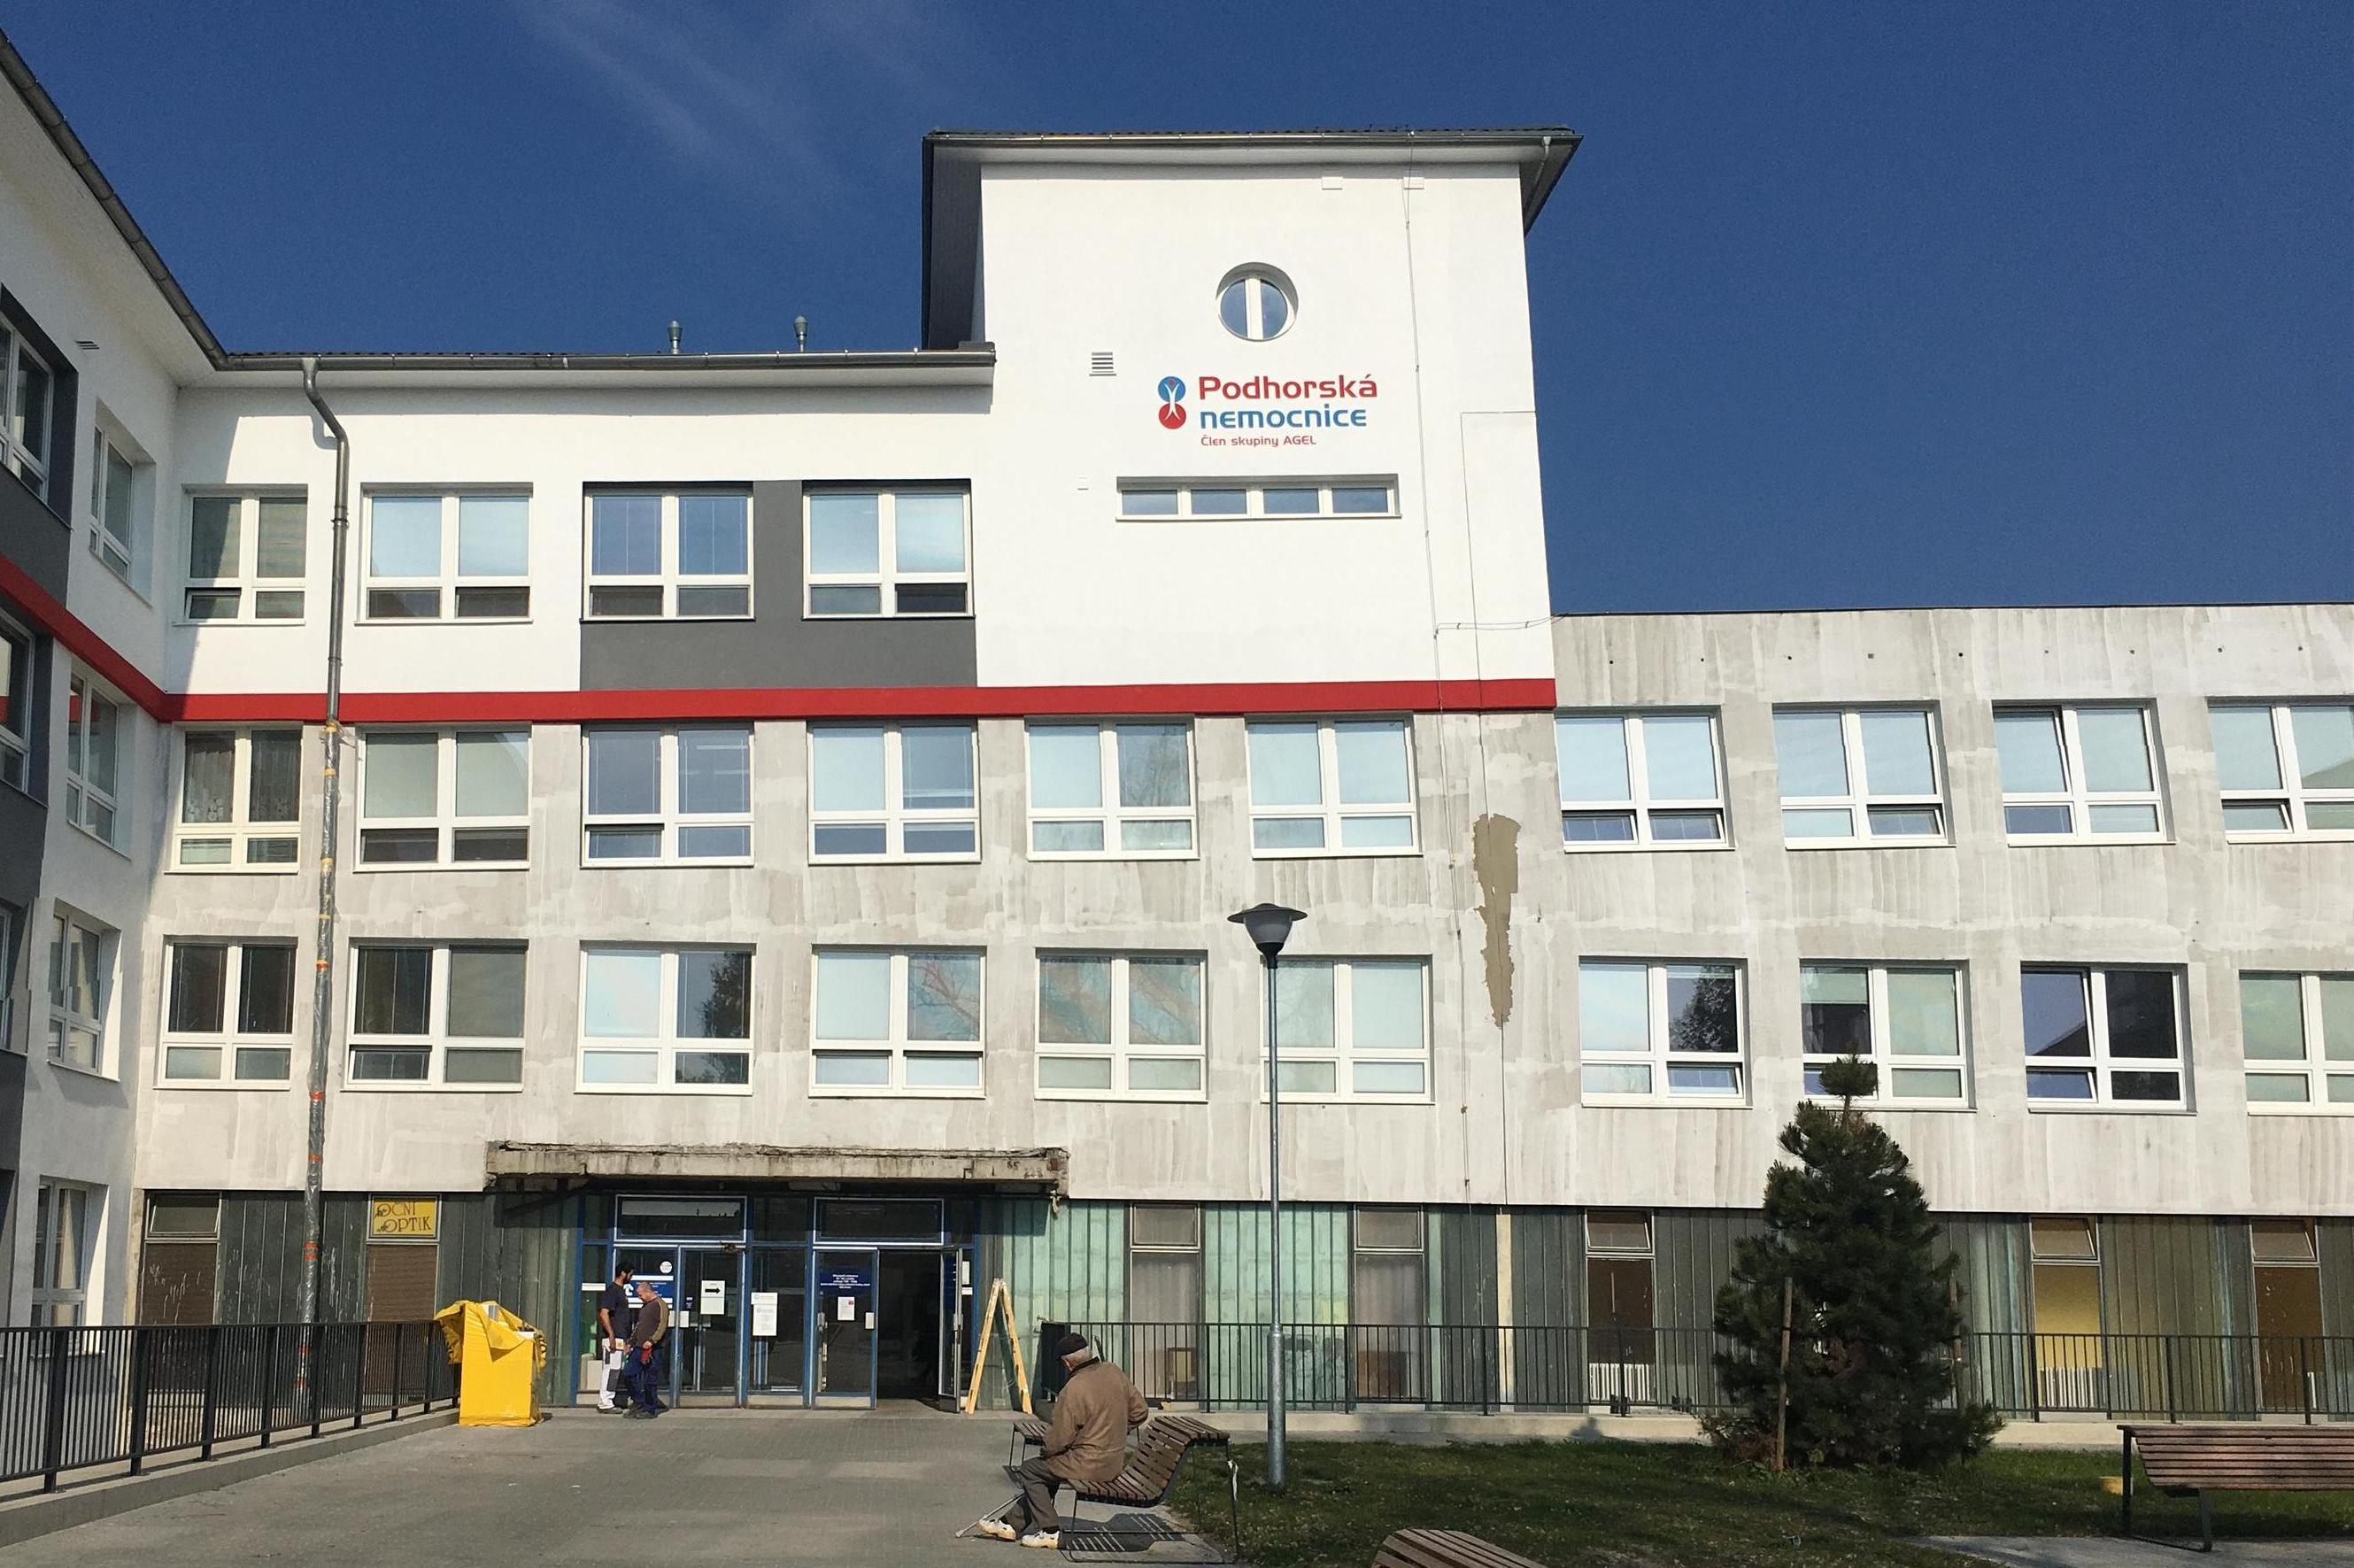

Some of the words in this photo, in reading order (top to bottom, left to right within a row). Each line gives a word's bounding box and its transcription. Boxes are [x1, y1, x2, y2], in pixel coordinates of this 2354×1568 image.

[1199, 374, 1378, 399] Podhorská
[1200, 404, 1366, 429] nemocnice
[1200, 435, 1226, 446] Člen
[1231, 436, 1278, 447] skupiny
[1283, 435, 1316, 445] AGEL
[378, 1216, 432, 1232] OPTIK
